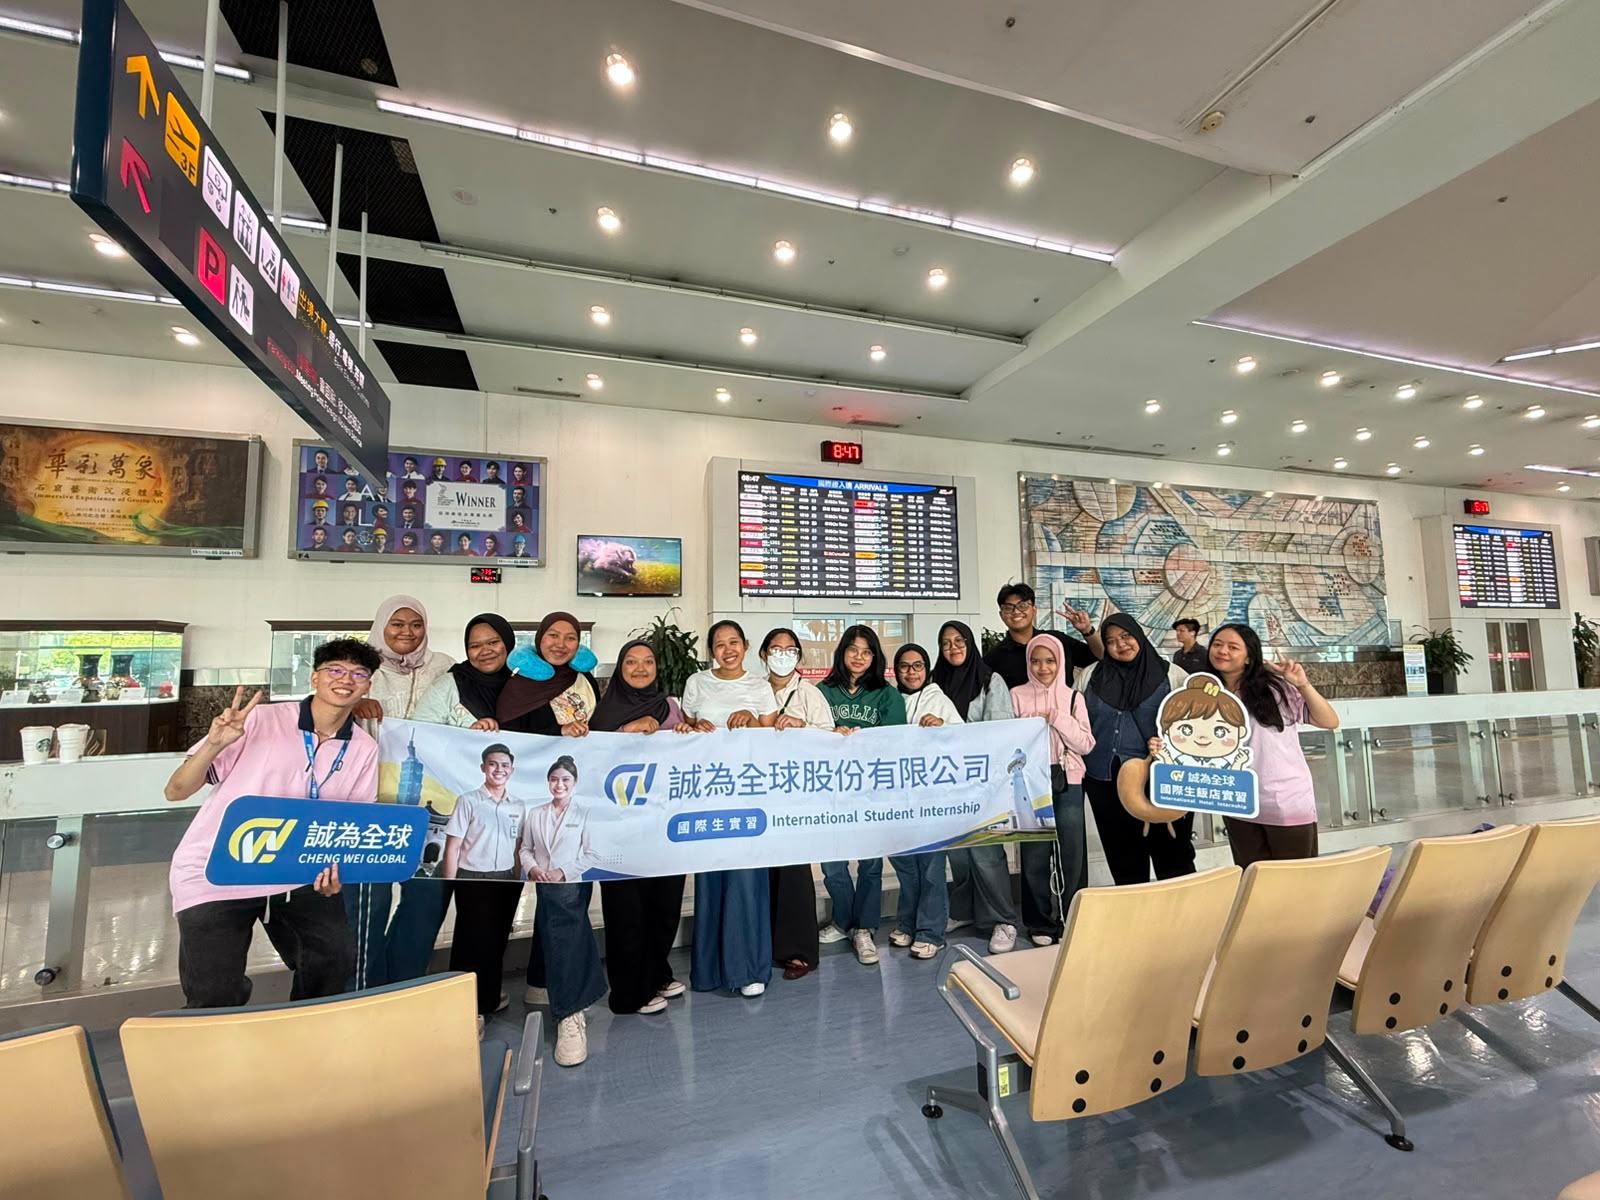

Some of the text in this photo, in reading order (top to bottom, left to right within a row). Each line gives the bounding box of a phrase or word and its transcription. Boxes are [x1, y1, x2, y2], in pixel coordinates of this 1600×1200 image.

[180, 153, 196, 180] 3F
[205, 240, 220, 280] P
[834, 444, 859, 459] 8:47
[854, 482, 888, 491] ARRIVALS
[34, 492, 73, 500] Immersive
[76, 494, 116, 502] Experience
[668, 754, 991, 801] 誠為全球股份有限公司
[1188, 771, 1236, 787] 誠為全球
[1160, 783, 1247, 803] 國際生飯店實習
[1160, 795, 1196, 804] International
[1217, 801, 1247, 810] Internship
[772, 801, 981, 827] International Student Internship
[303, 820, 414, 850] 誠為全球
[677, 815, 757, 835] 國際生實習
[298, 853, 407, 864] CHENG WEI GLOBAL
